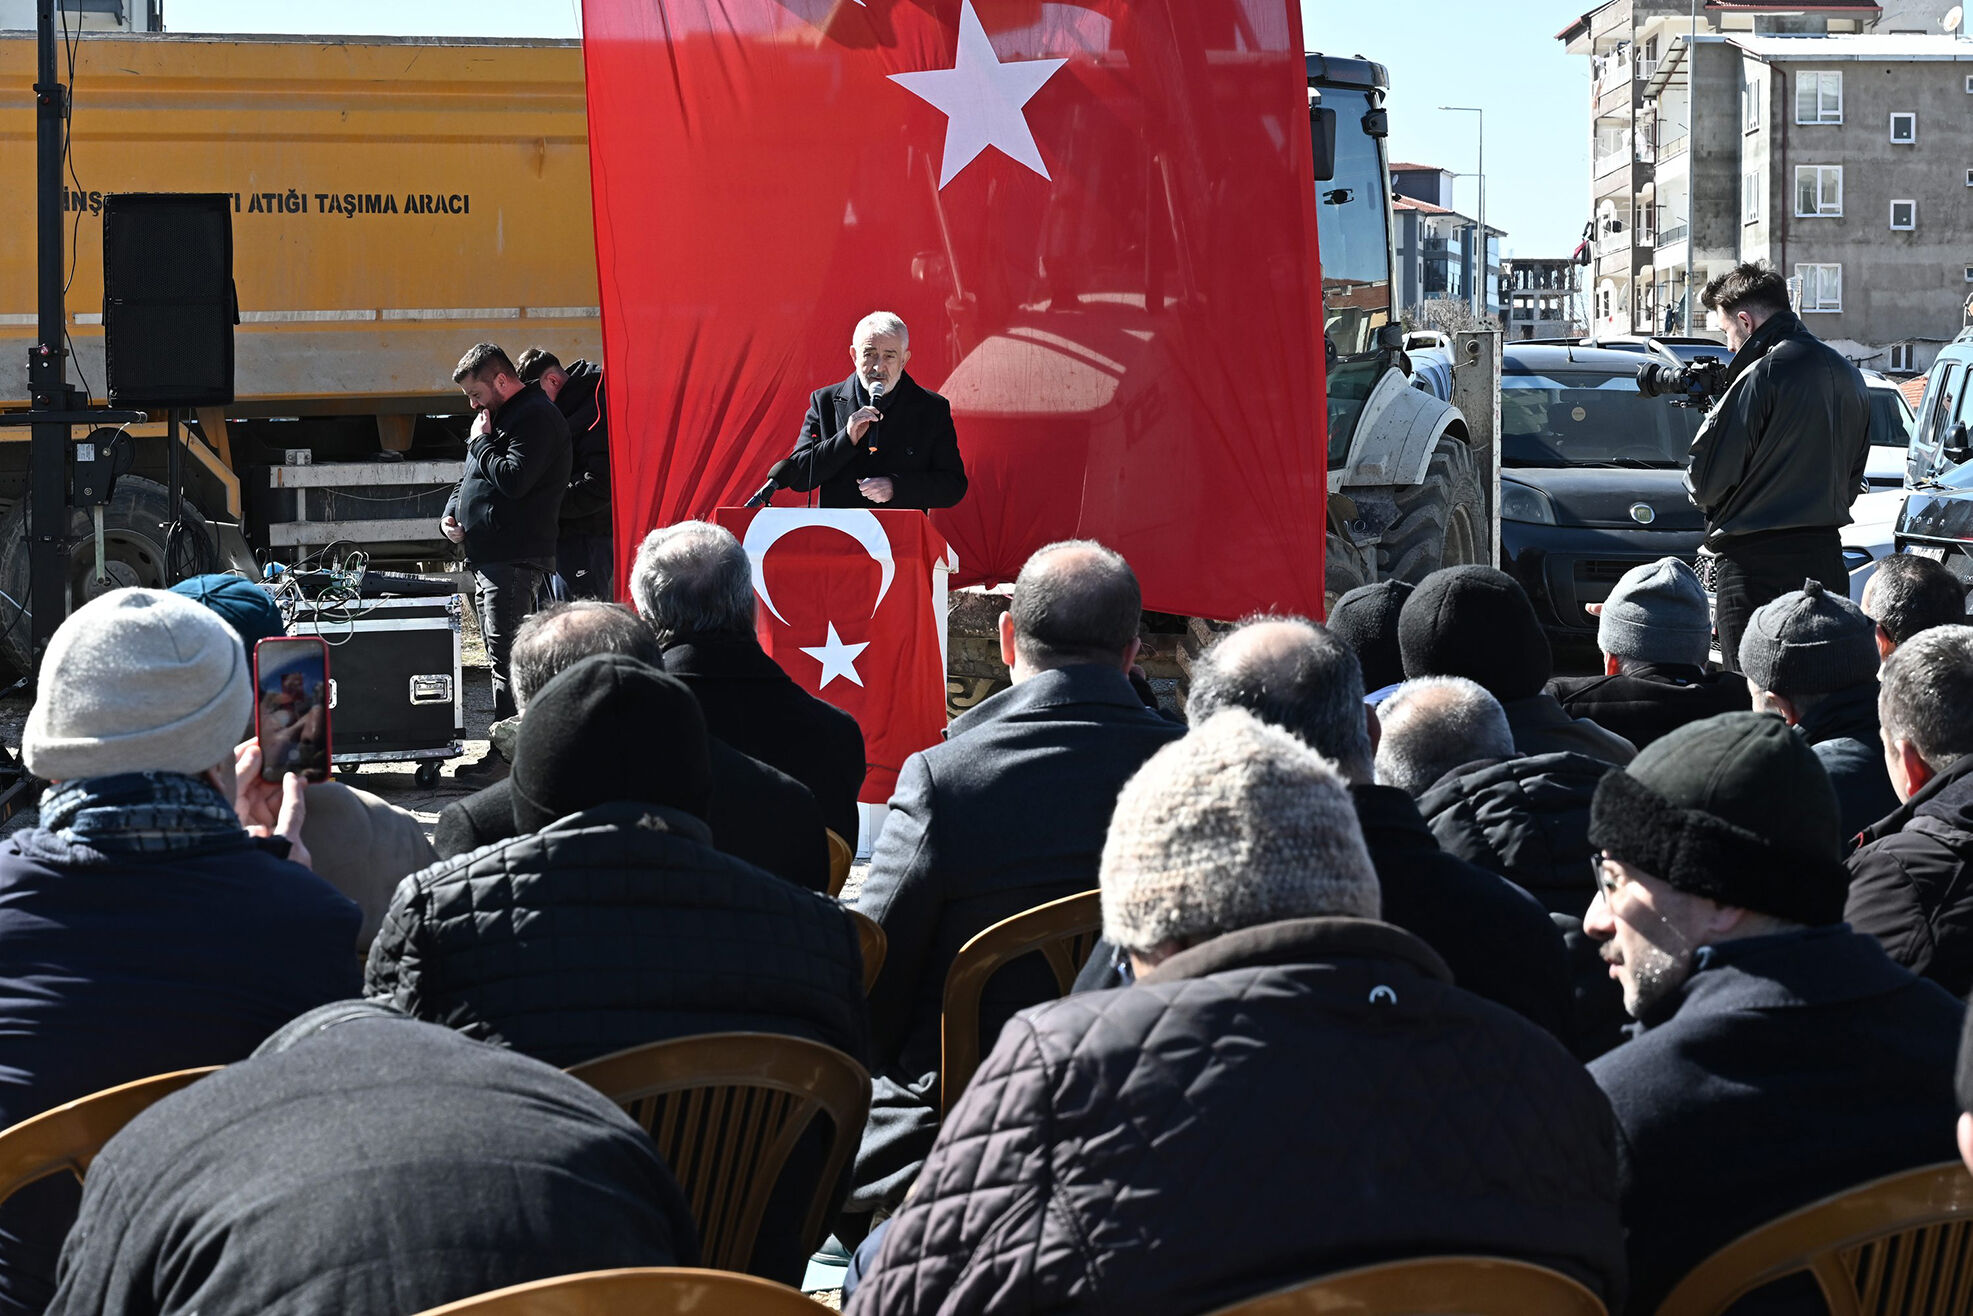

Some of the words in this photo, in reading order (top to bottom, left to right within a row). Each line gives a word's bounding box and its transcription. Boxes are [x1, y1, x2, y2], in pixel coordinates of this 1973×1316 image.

[248, 188, 307, 213] ATIĞI
[314, 193, 399, 219] TAŞIMA
[403, 194, 470, 214] ARACI
